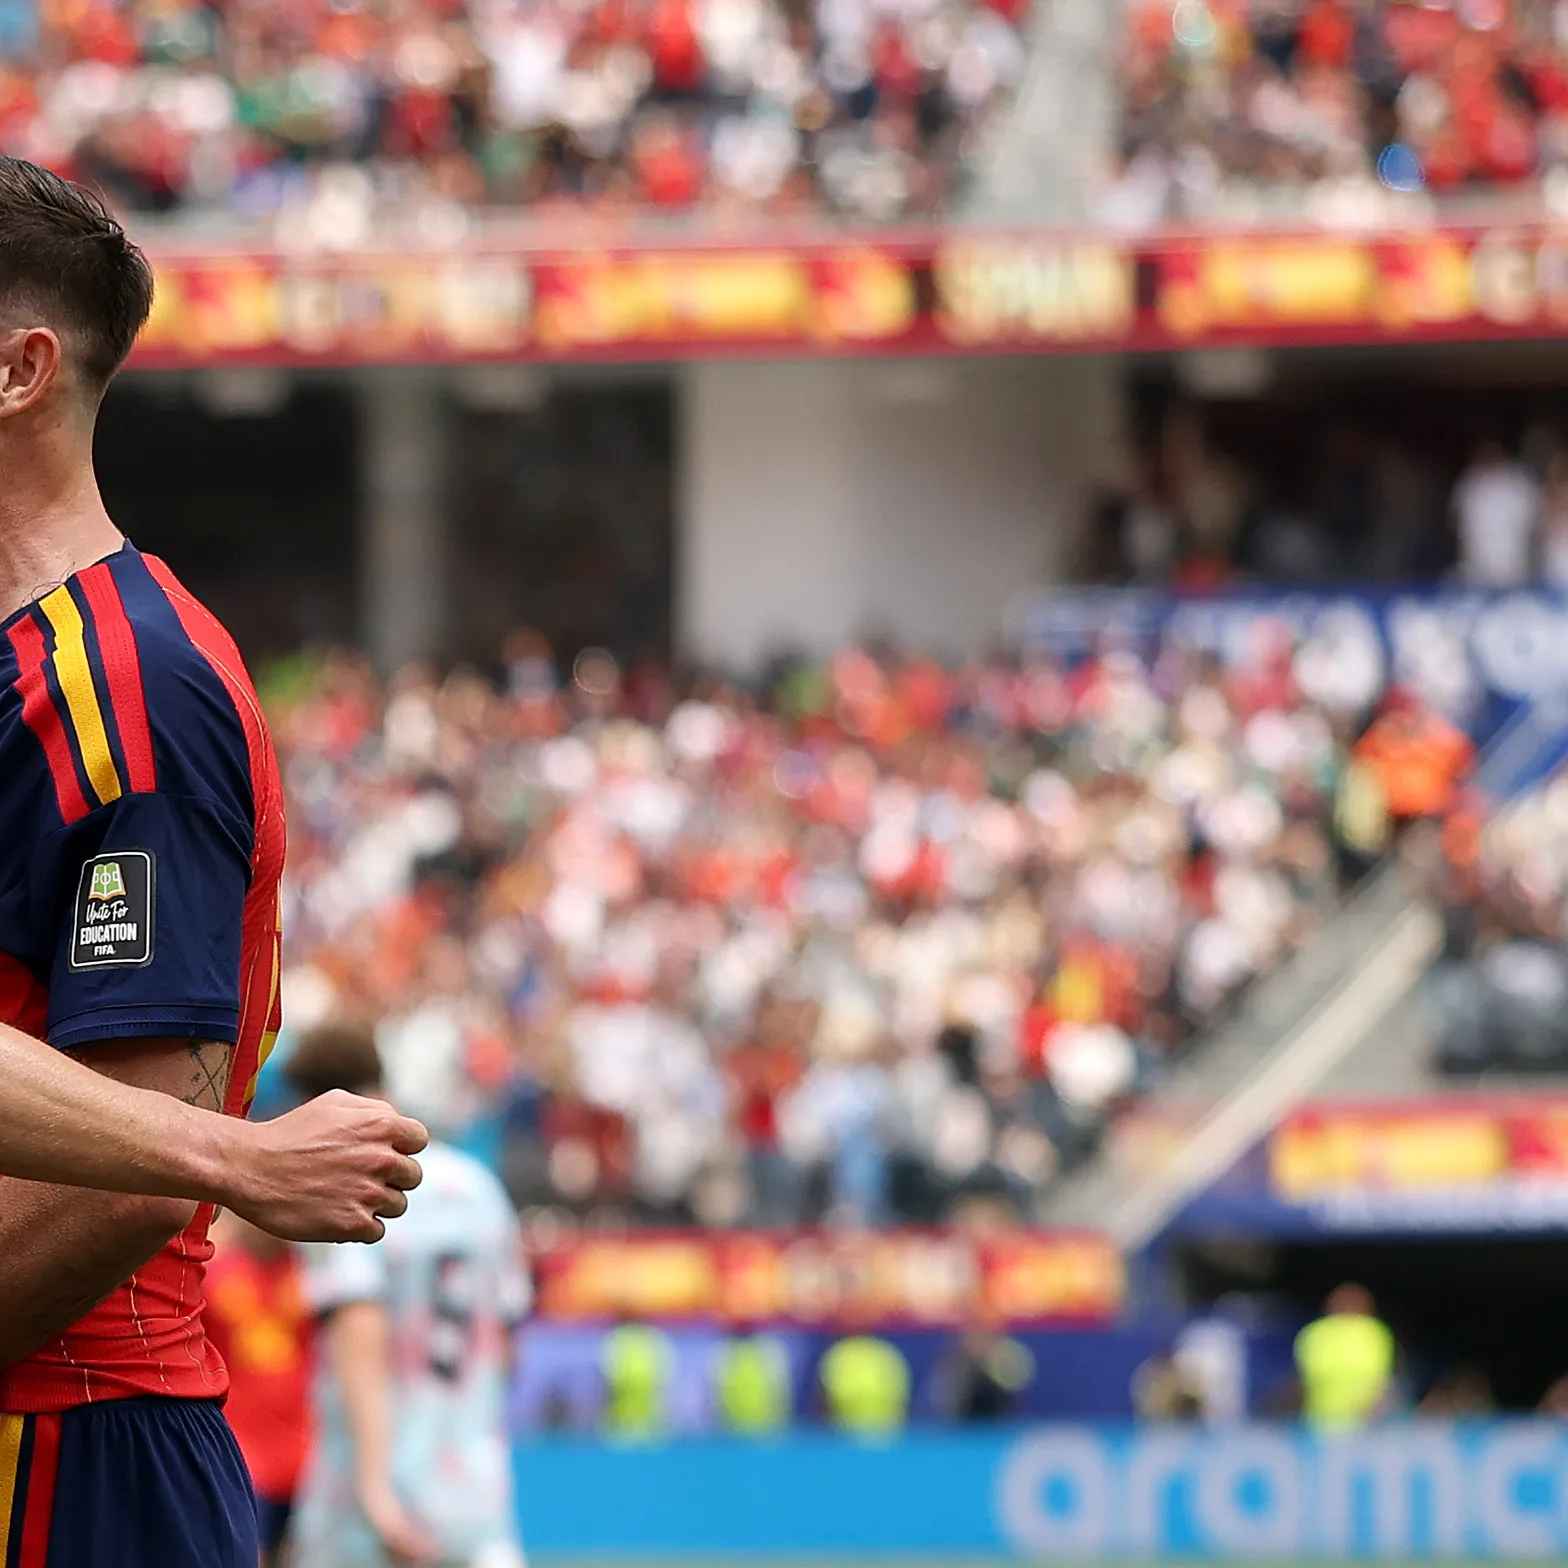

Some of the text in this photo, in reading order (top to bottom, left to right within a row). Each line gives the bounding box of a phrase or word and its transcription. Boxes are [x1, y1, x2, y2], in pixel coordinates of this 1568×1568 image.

[111, 900, 129, 922] For
[80, 923, 138, 945] EDUCATION
[94, 944, 116, 956] FIFA
